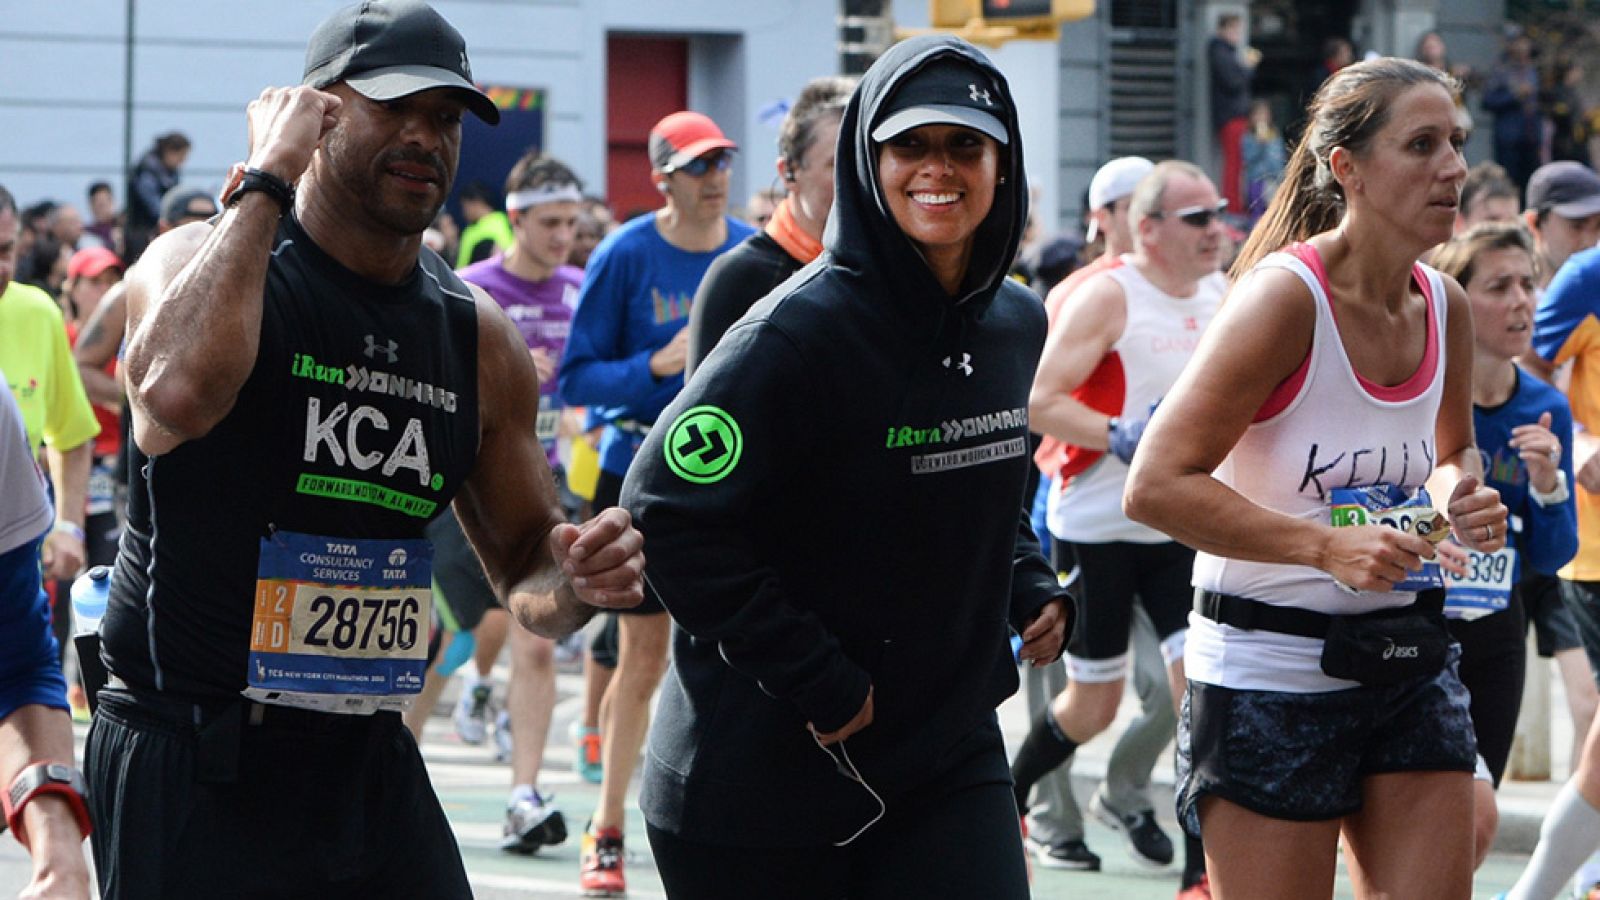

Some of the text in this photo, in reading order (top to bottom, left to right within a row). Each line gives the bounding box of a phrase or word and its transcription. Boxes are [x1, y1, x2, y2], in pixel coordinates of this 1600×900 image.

[291, 352, 345, 385] iRun
[885, 425, 942, 449] iRun
[1298, 438, 1433, 500] KELLY
[326, 543, 357, 556] TATA
[300, 552, 375, 570] CONSULTANCY
[312, 568, 360, 581] SERVICES
[382, 569, 407, 579] TATA
[274, 585, 288, 613] 2
[303, 595, 419, 651] 28756
[271, 621, 284, 648] D
[1394, 645, 1418, 658] asics
[268, 669, 283, 678] TCS
[285, 671, 301, 679] NEW
[302, 672, 321, 680] YORK
